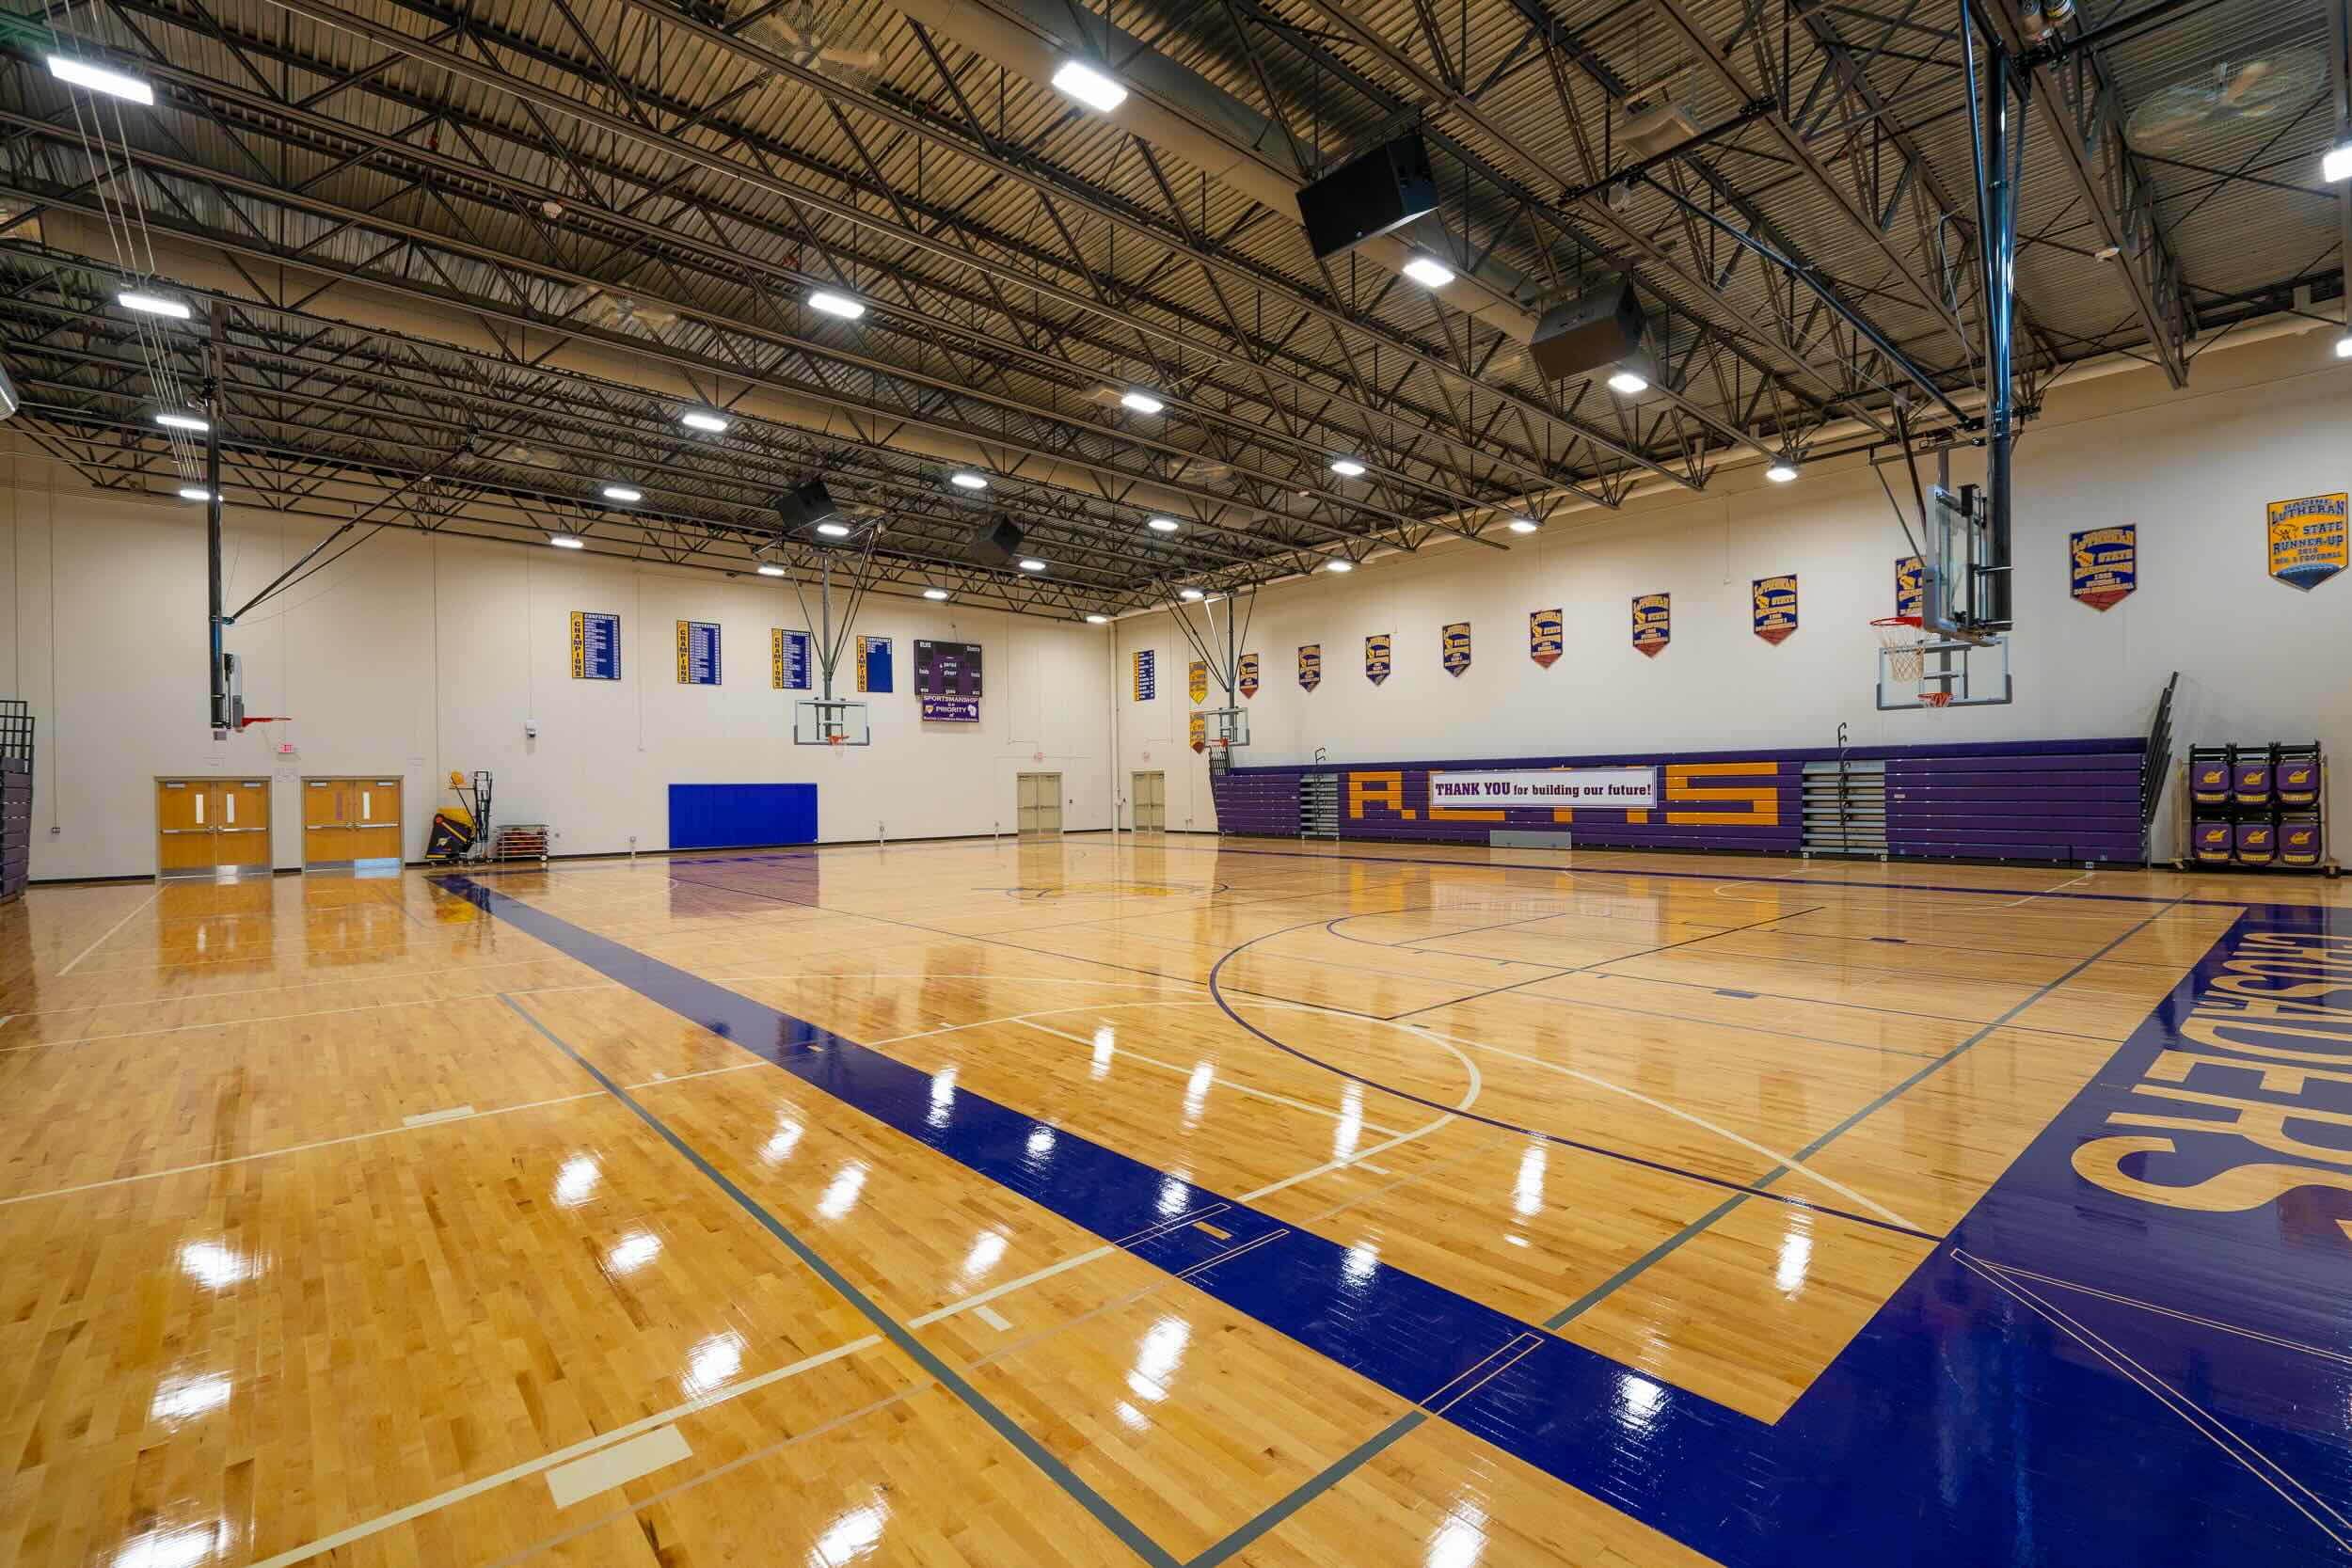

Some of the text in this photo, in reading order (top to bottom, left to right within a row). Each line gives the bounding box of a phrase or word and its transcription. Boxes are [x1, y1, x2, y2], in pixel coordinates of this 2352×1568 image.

[2271, 500, 2344, 524] LUTHERAN
[2303, 521, 2343, 534] STATE
[2273, 535, 2344, 555] RUNNER-UP
[1435, 782, 1651, 798] THANK YOU for building our future!
